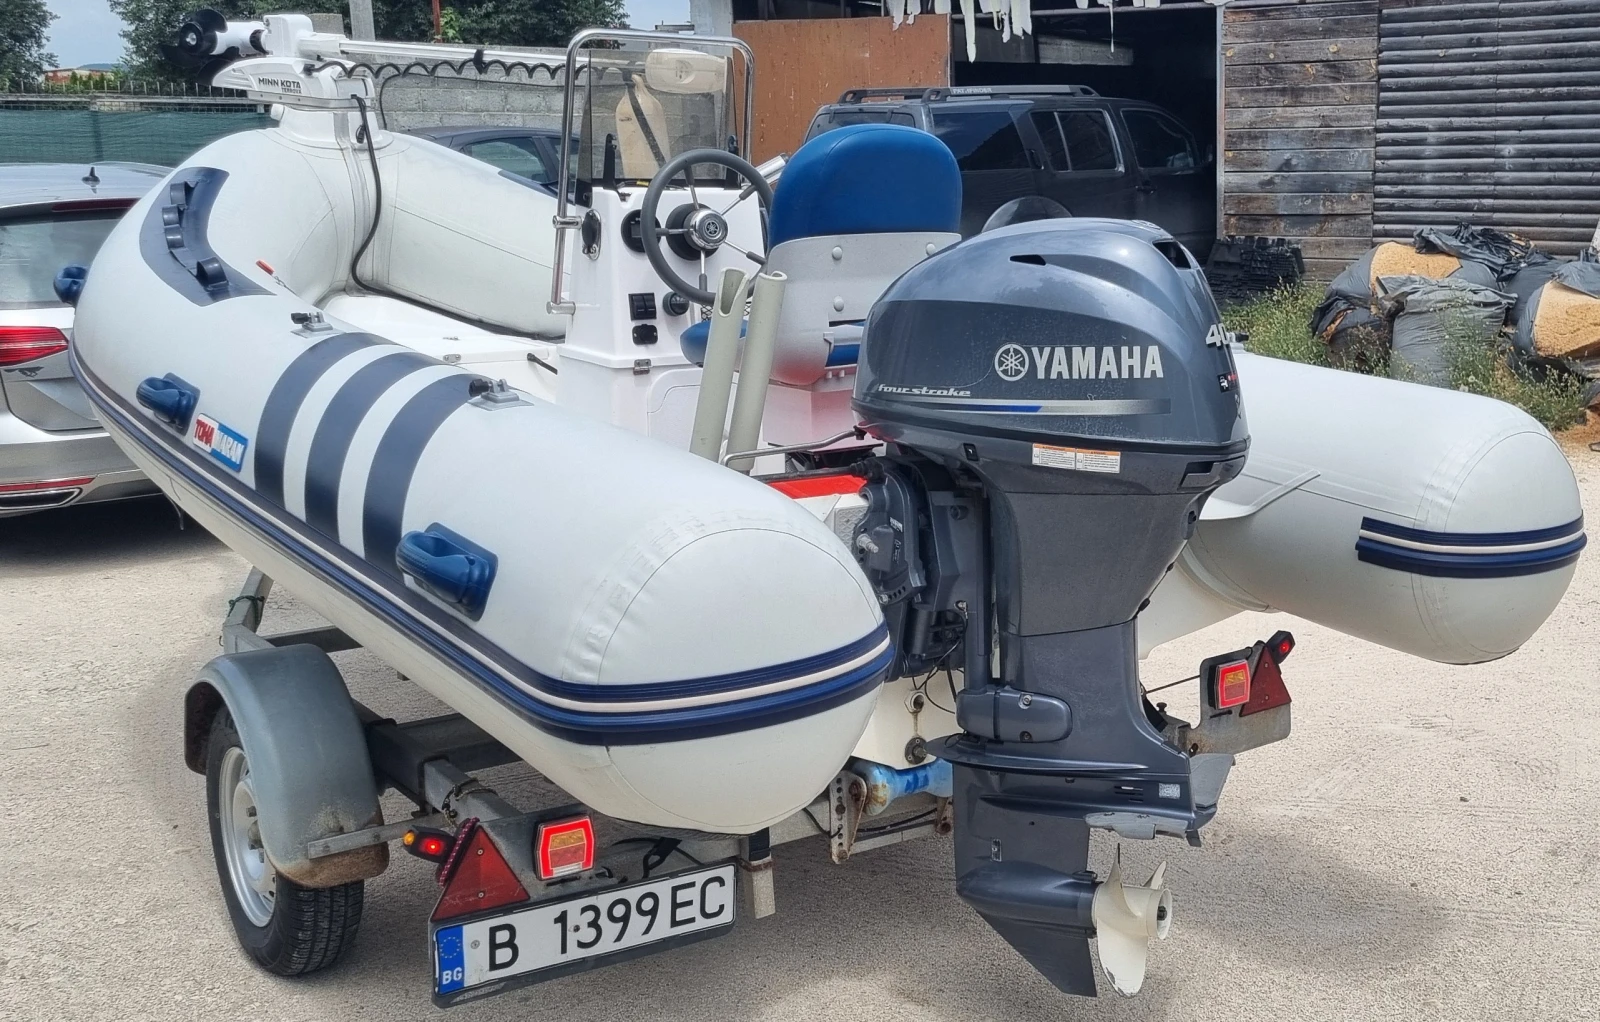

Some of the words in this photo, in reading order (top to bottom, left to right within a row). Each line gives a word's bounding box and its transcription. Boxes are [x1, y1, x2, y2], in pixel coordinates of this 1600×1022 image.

[258, 78, 279, 87] MINN
[280, 80, 301, 89] KOTA
[1031, 345, 1164, 379] YAMAHA
[487, 923, 520, 972] B
[553, 891, 660, 955] 1399
[670, 875, 726, 928] EC
[442, 966, 463, 986] BG
